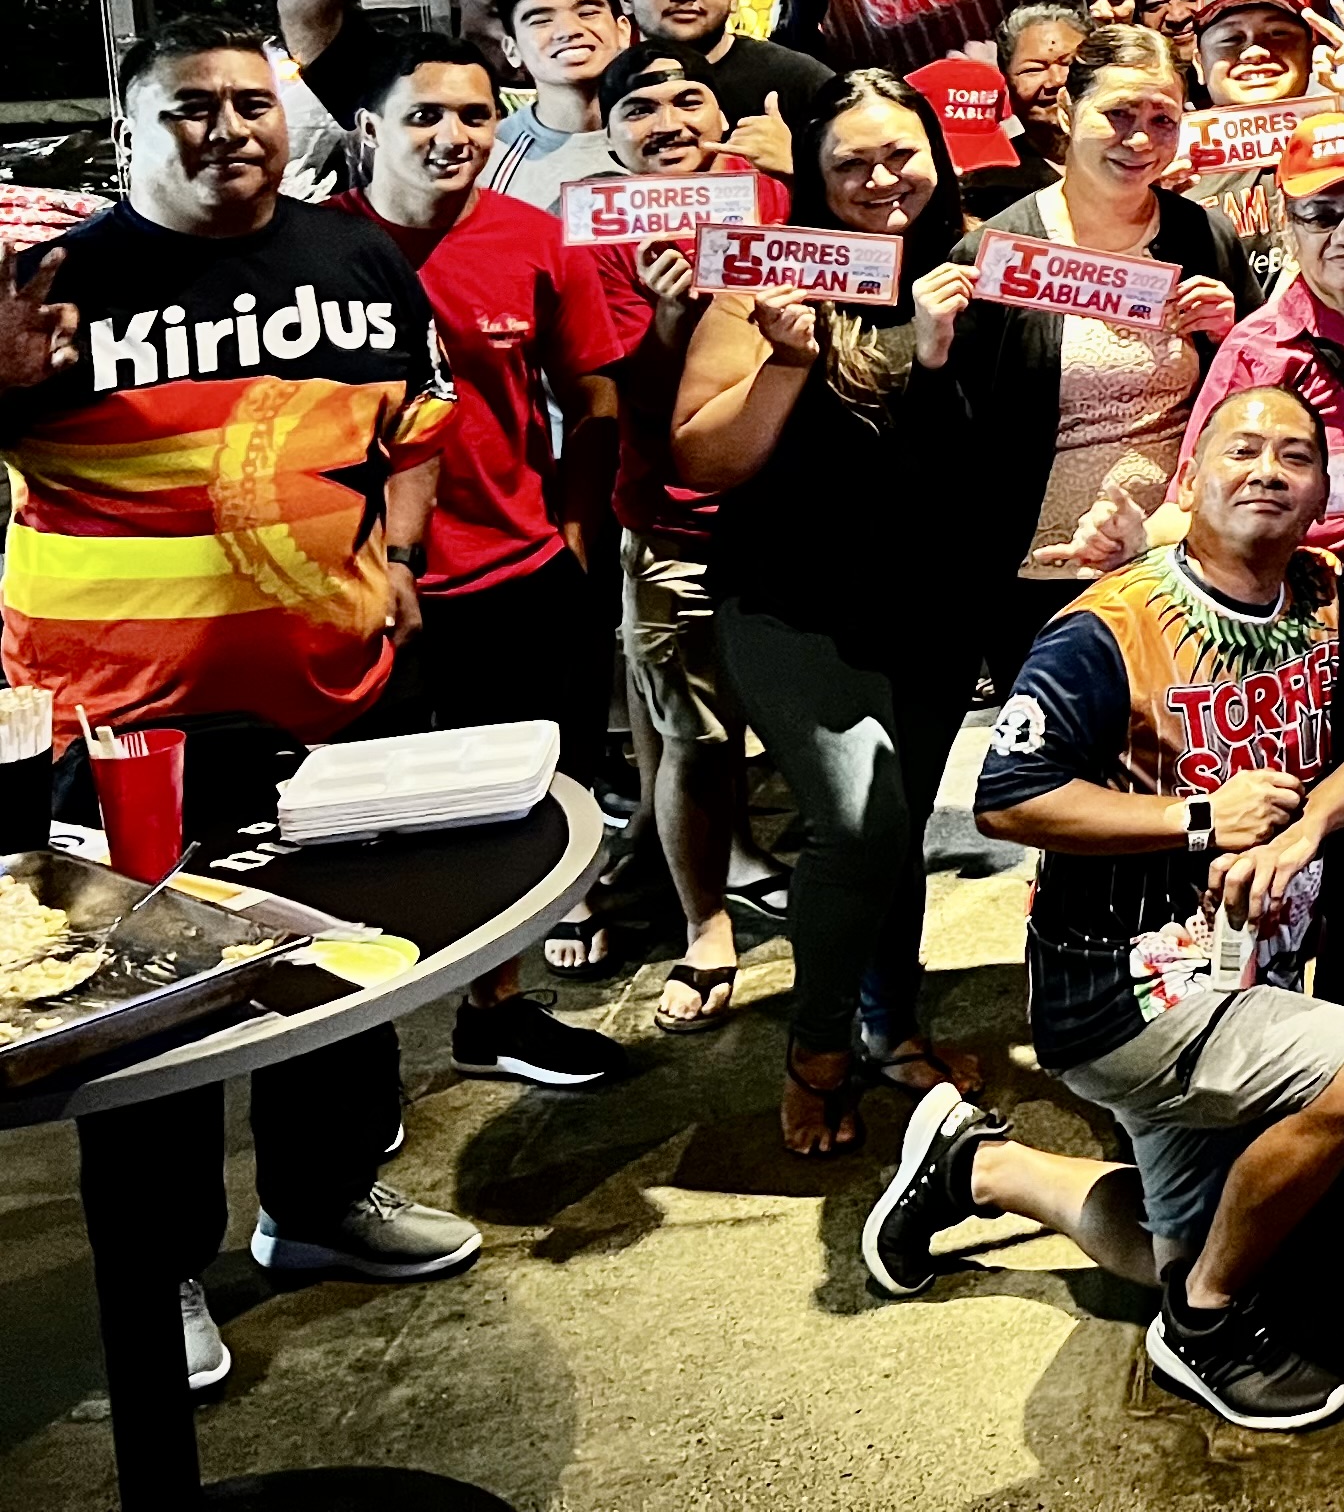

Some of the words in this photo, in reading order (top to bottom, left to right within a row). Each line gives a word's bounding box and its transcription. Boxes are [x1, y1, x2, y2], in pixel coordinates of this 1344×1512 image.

[1188, 111, 1298, 146] TORRES
[1189, 136, 1289, 168] SABLA
[591, 185, 711, 214] TORRES
[591, 208, 711, 237] SABLAN
[727, 231, 850, 267] TORRES
[1011, 242, 1129, 288] TORRES
[1130, 272, 1168, 291] 2022
[721, 253, 849, 293] SABLAN
[1000, 264, 1122, 315] SABLAN
[89, 285, 396, 392] Kiridus
